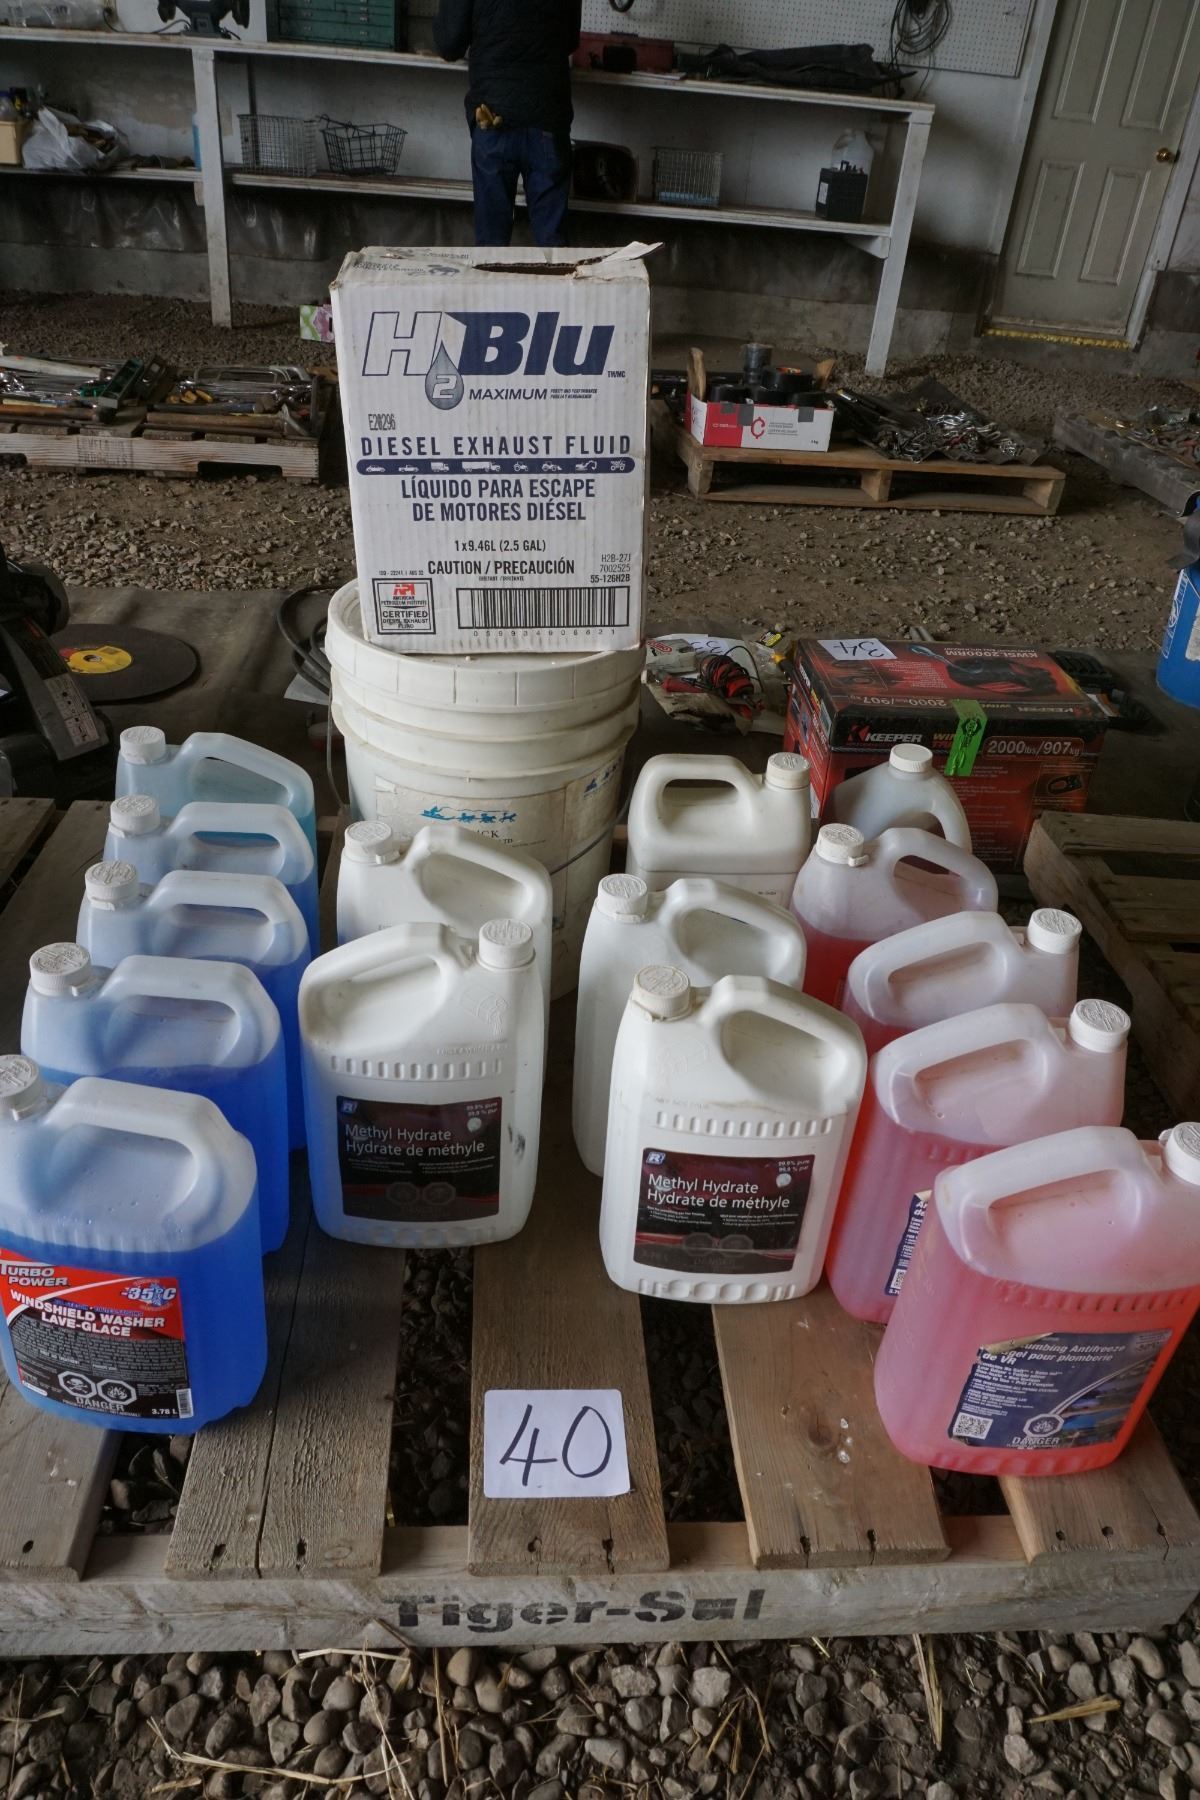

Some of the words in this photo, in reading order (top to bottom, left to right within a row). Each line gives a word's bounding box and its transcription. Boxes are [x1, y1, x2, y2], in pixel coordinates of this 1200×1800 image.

[469, 388, 547, 400] MAXIMUM
[361, 436, 441, 457] DIESEL
[453, 436, 552, 456] EXHAUST
[565, 435, 631, 455] FLUID
[401, 475, 472, 499] LÍQUIDO
[478, 479, 523, 498] PARA
[529, 478, 595, 497] ESCAPE
[412, 503, 435, 522] DE
[440, 502, 521, 521] MOTORES
[527, 498, 586, 521] DIÉSEL
[499, 540, 520, 552] (2.5
[523, 540, 546, 552] GAL)
[428, 560, 482, 575] CAUTION
[485, 560, 492, 575] /
[494, 556, 575, 575] PRECAUCIÓN
[382, 610, 428, 618] CERTIFIED
[865, 734, 923, 743] KEEPER
[345, 1123, 393, 1142] Methyl
[397, 1127, 451, 1143] Hydrate
[345, 1139, 402, 1156] Hydrate
[406, 1143, 424, 1157] de
[428, 1139, 485, 1157] méthyle
[648, 1173, 699, 1192] Methyl
[703, 1181, 759, 1195] Hydrate
[647, 1188, 704, 1207] Hydrate
[709, 1194, 728, 1208] de
[731, 1195, 790, 1212] méthyle
[9, 1276, 68, 1287] POWER
[10, 1289, 96, 1322] WINDSHIELD
[100, 1313, 165, 1328] WASHER
[41, 1311, 131, 1337] LAVE-GLACE
[1069, 1344, 1126, 1353] Antifreeze
[982, 1353, 998, 1361] de
[1000, 1356, 1018, 1365] VR
[1056, 1354, 1114, 1362] plomberie
[75, 1396, 126, 1412] DANGER
[498, 1403, 613, 1487] 40
[1012, 1436, 1061, 1445] DANGER
